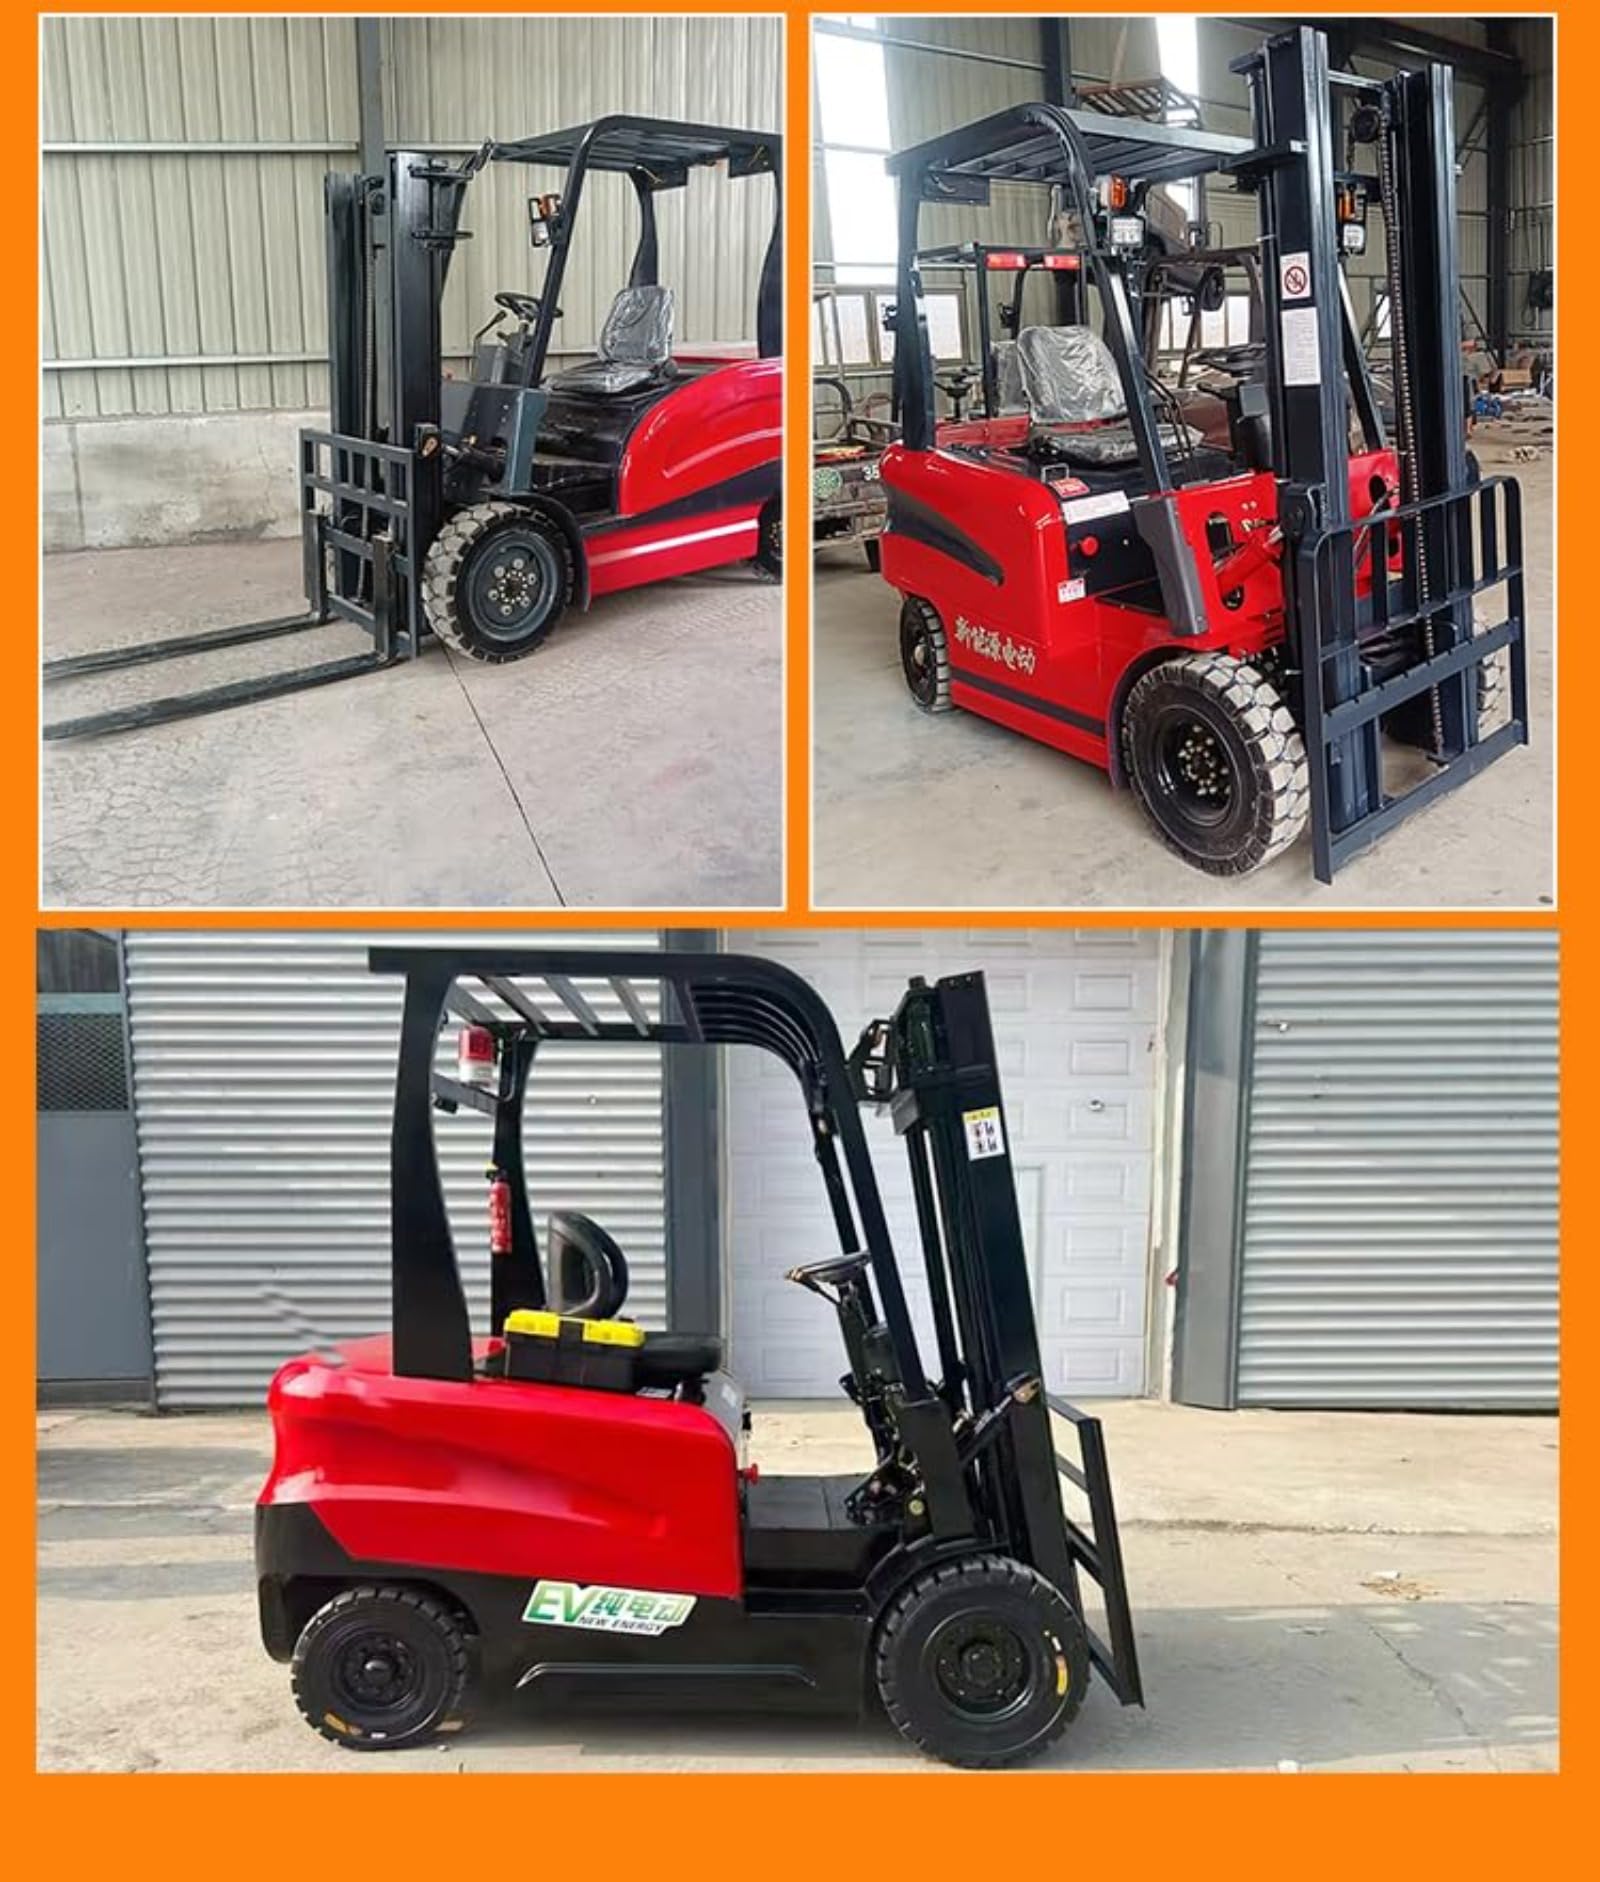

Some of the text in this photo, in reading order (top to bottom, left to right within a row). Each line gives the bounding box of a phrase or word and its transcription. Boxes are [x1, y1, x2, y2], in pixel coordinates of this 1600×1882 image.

[954, 615, 1036, 675] 新能源电动
[527, 1583, 597, 1622] EV
[579, 1615, 664, 1632] NEW ENERGY
